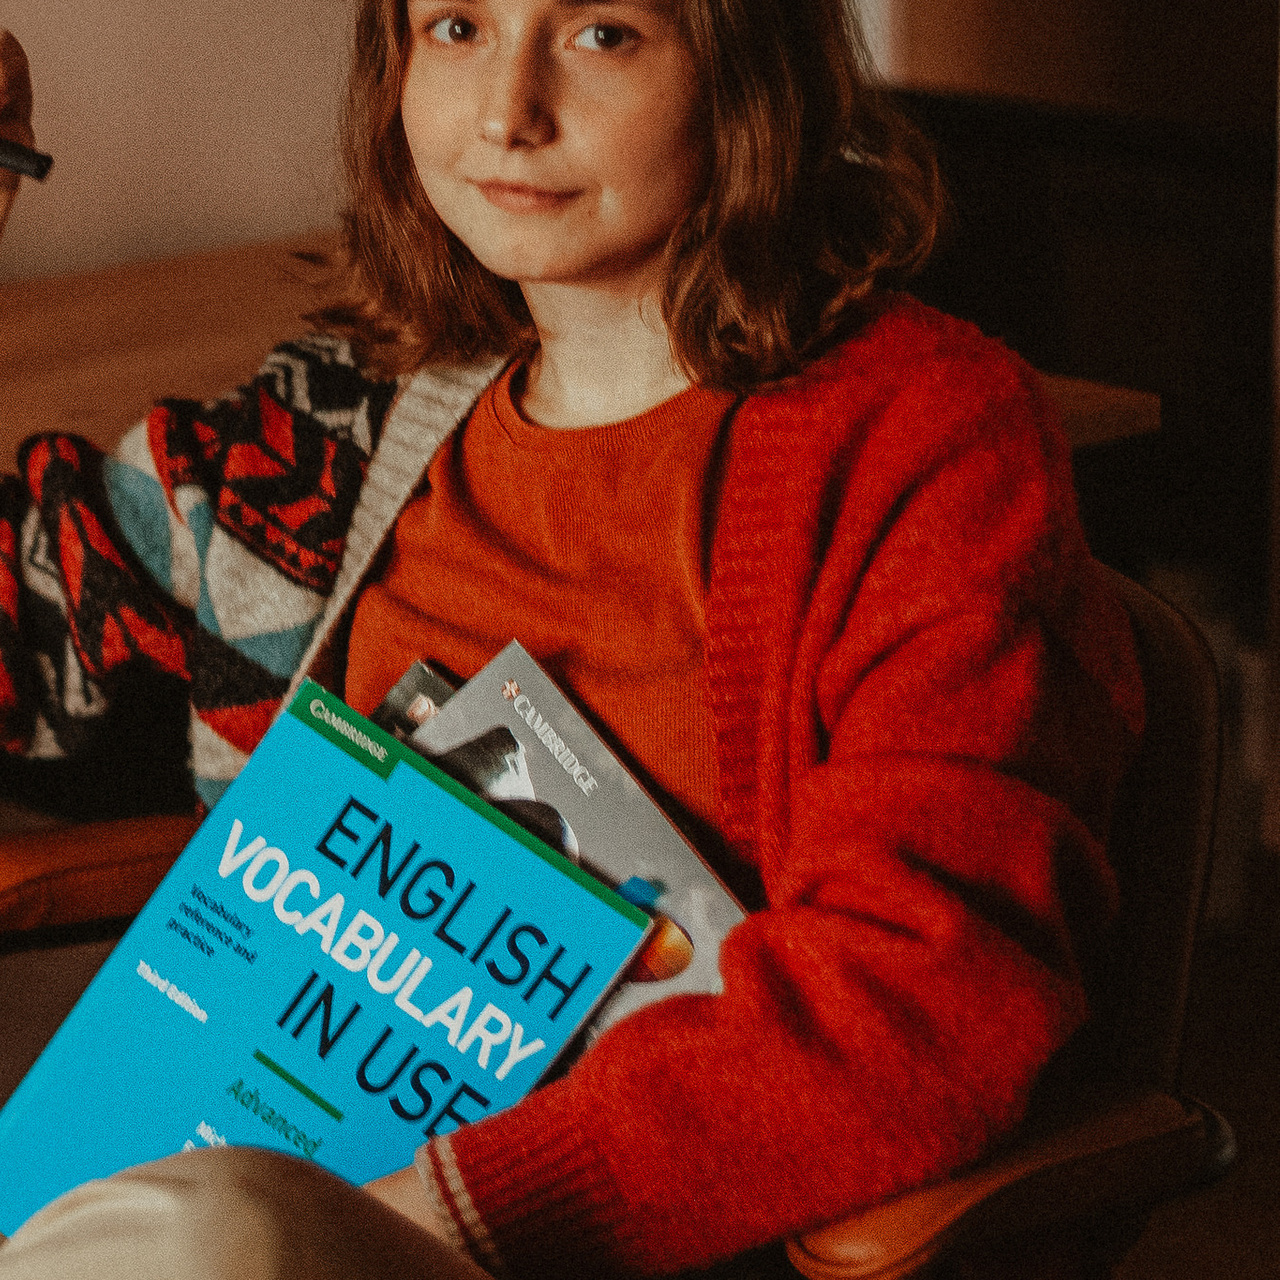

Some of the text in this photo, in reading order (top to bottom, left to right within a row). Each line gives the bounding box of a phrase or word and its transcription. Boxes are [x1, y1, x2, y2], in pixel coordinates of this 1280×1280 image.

[309, 697, 388, 763] CAMBRIDGE
[513, 693, 598, 797] CAMBRIDGE
[166, 916, 215, 959] practice
[218, 818, 546, 1081] VOCABULARY
[231, 938, 258, 966] and
[315, 794, 593, 1022] ENGLISH
[276, 968, 492, 1138] IN USE
[225, 1078, 323, 1160] Advanced
